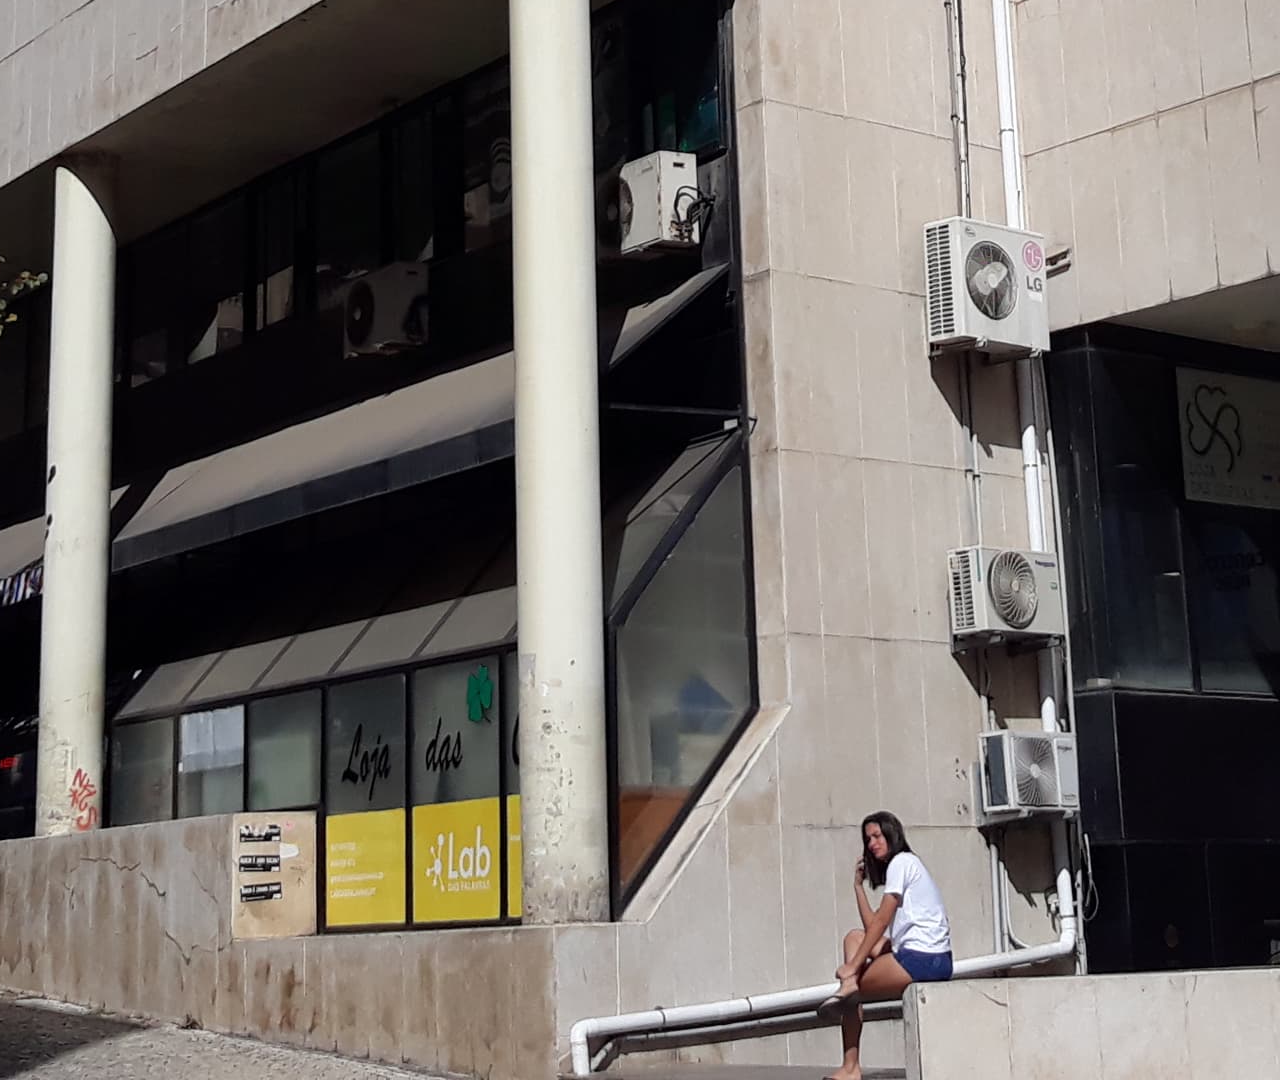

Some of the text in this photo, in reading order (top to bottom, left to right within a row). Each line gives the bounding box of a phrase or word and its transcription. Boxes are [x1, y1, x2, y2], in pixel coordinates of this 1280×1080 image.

[1026, 275, 1043, 293] LG
[341, 723, 391, 801] Loja
[425, 717, 463, 772] das
[447, 825, 492, 880] Lab
